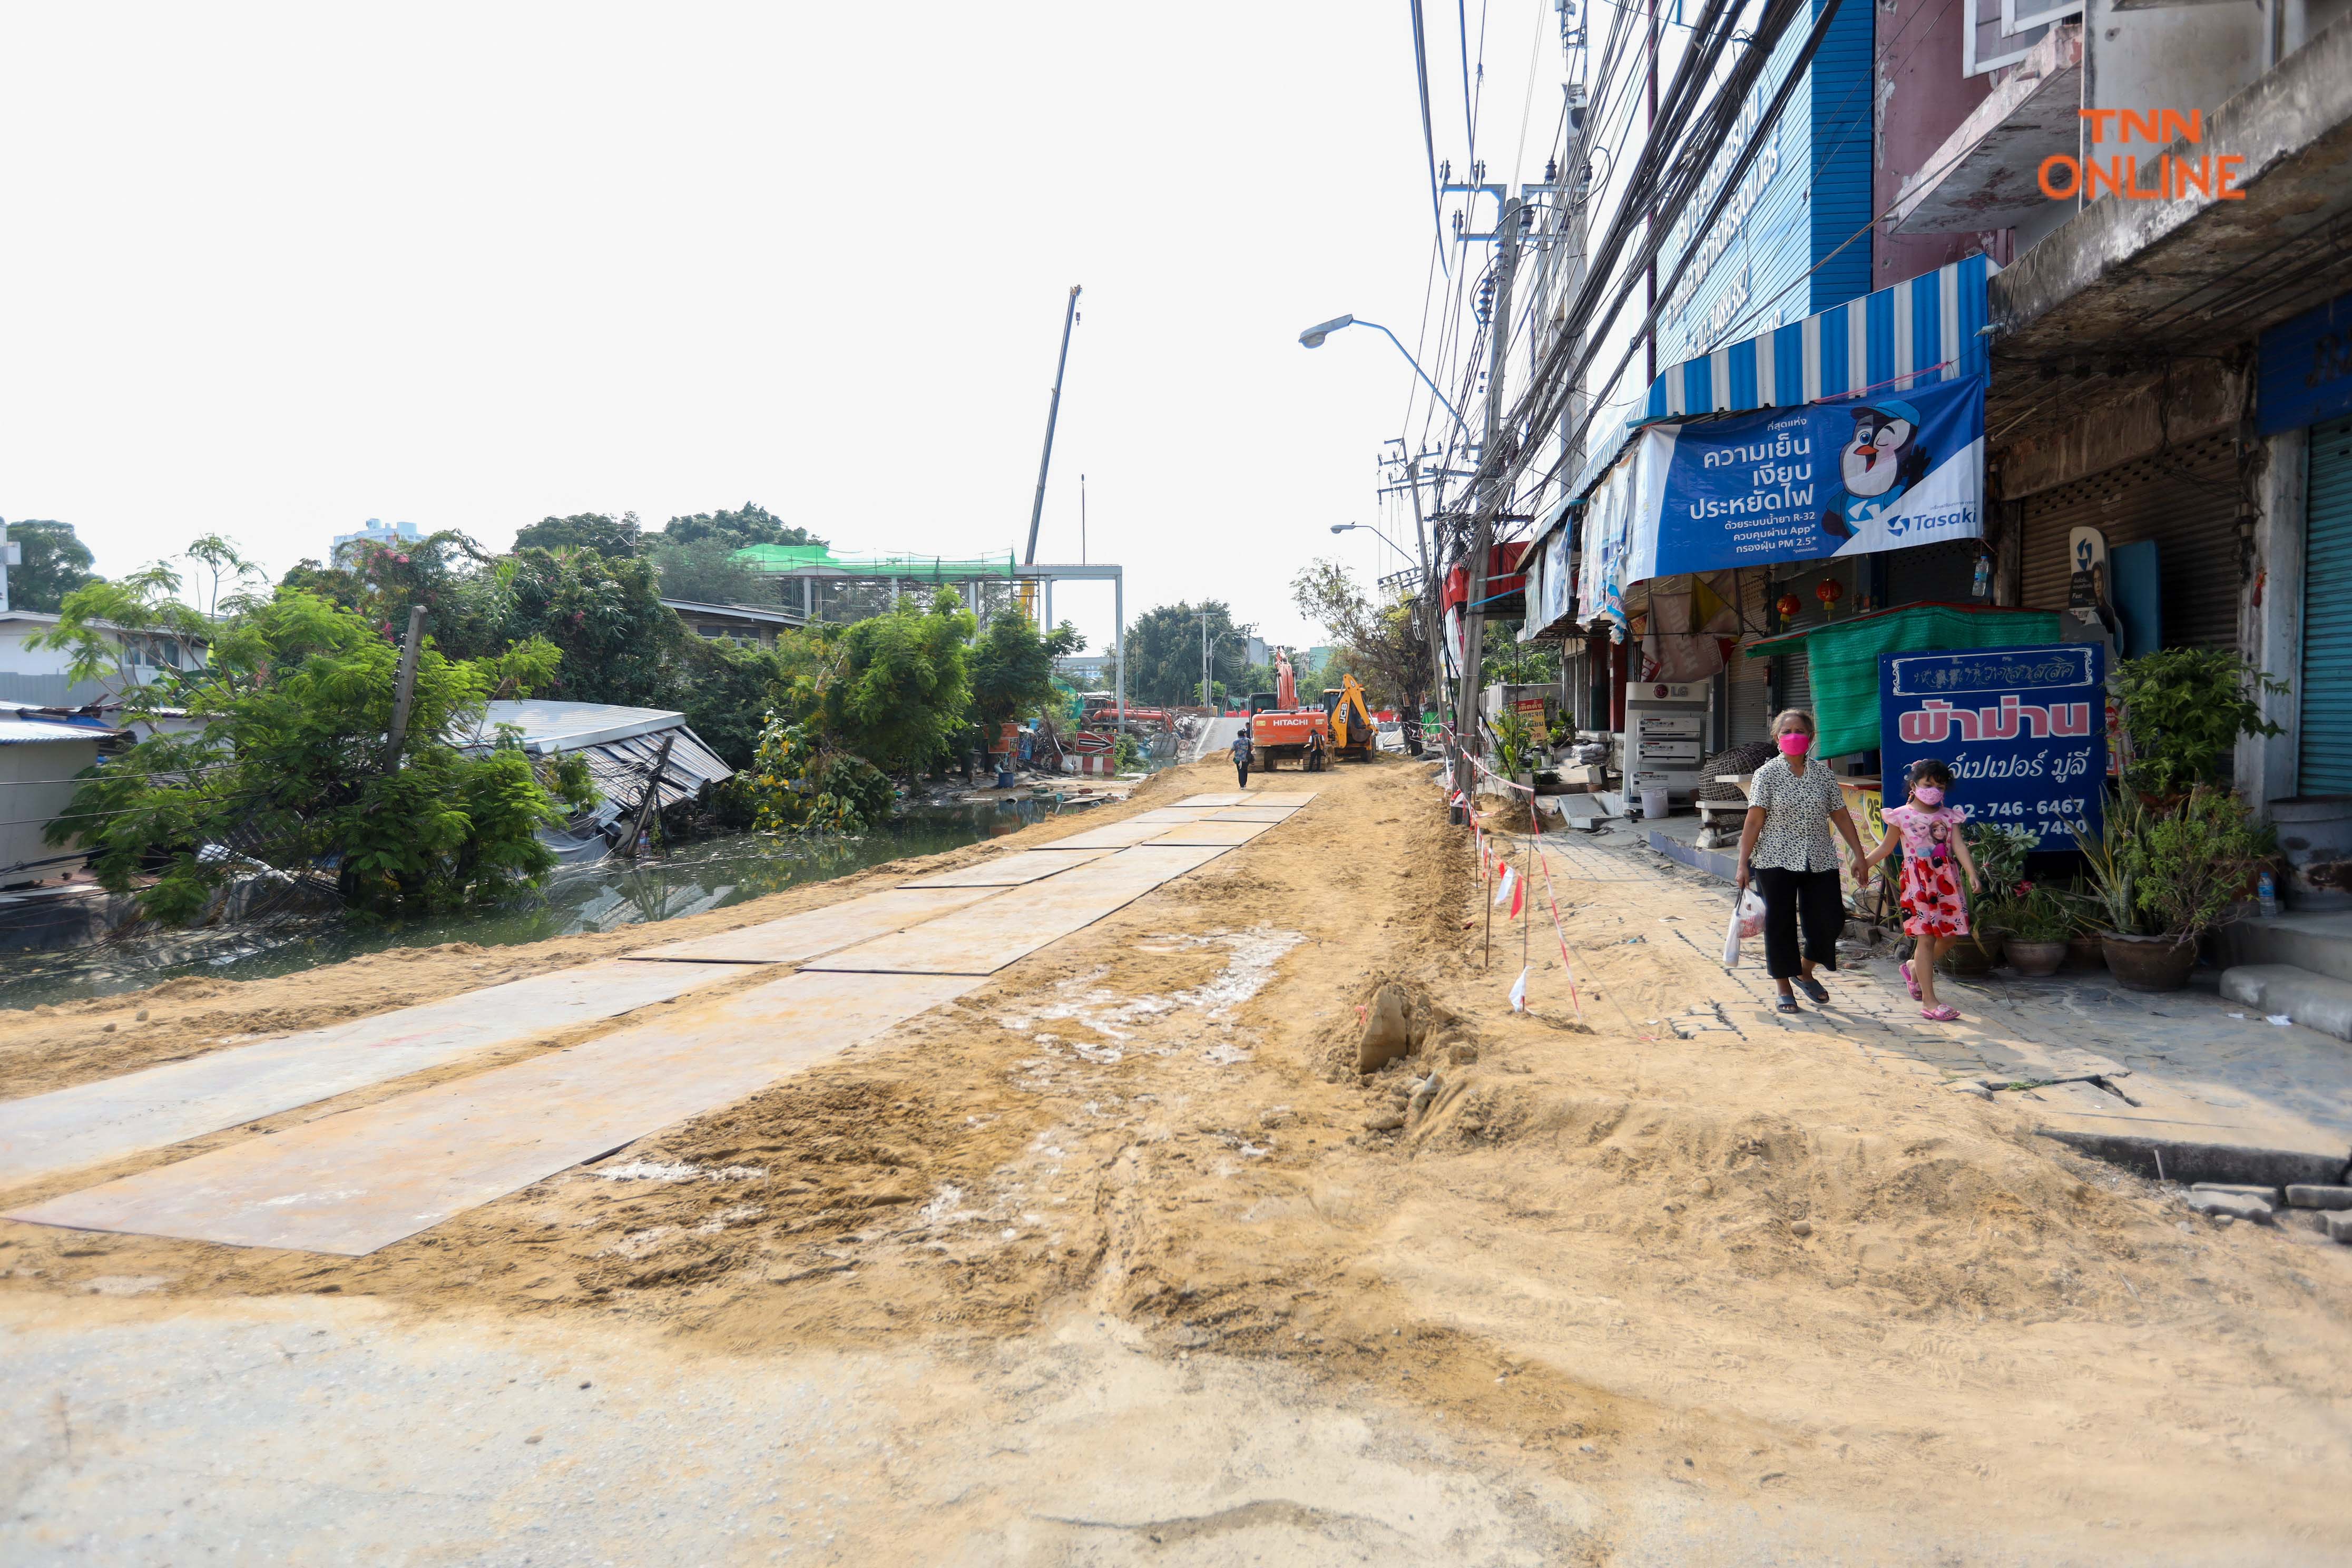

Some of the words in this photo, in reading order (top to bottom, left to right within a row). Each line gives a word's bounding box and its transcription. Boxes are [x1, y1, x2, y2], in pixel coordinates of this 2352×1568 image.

[1767, 417, 1807, 431] ที่สุดแห่ง
[1704, 433, 1810, 468] ความเย็น
[1753, 462, 1811, 486] เงียบ
[1690, 483, 1814, 520] ประหยัดไฟ
[1725, 514, 1790, 530] ด้วยระบบน้ำยา
[1794, 512, 1815, 522] R-32
[1914, 508, 1976, 530] Tasaki
[1733, 527, 1787, 541] ควบคุมผ่าน
[1736, 541, 1775, 553] กรองฝุ่น
[1778, 539, 1793, 548] PM
[1670, 686, 1688, 697] LG
[1899, 694, 2090, 743] ผ้าม่าน
[2051, 747, 2091, 783] มู่ลี่
